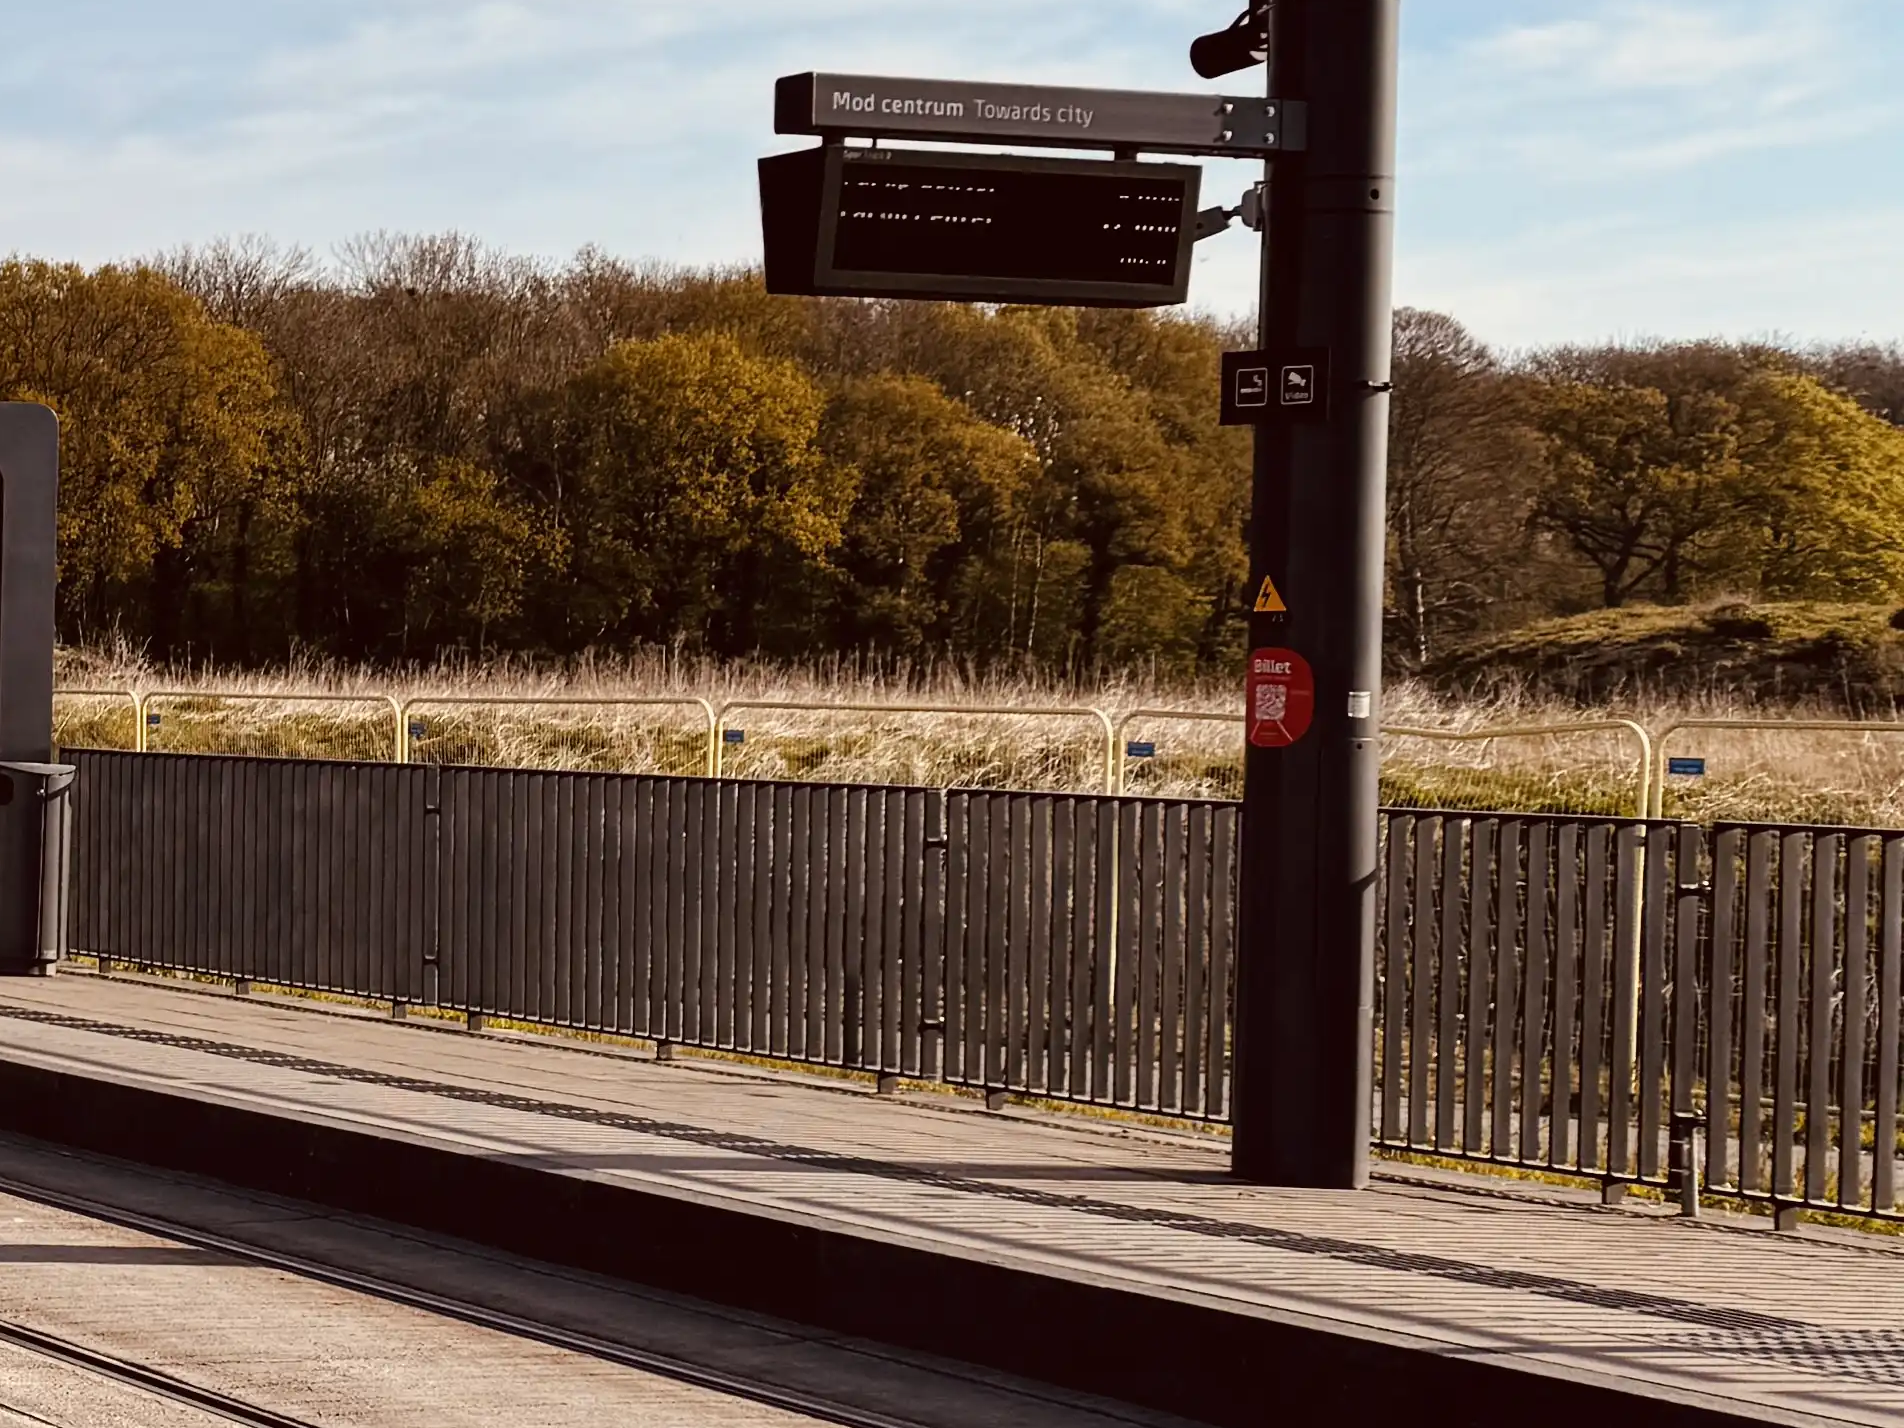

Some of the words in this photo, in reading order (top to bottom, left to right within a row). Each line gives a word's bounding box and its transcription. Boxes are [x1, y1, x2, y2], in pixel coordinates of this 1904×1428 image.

[832, 91, 875, 112] Mod
[881, 96, 964, 117] centrum
[973, 99, 1051, 122] Towards
[1057, 105, 1093, 128] city
[1254, 659, 1292, 674] Billet
